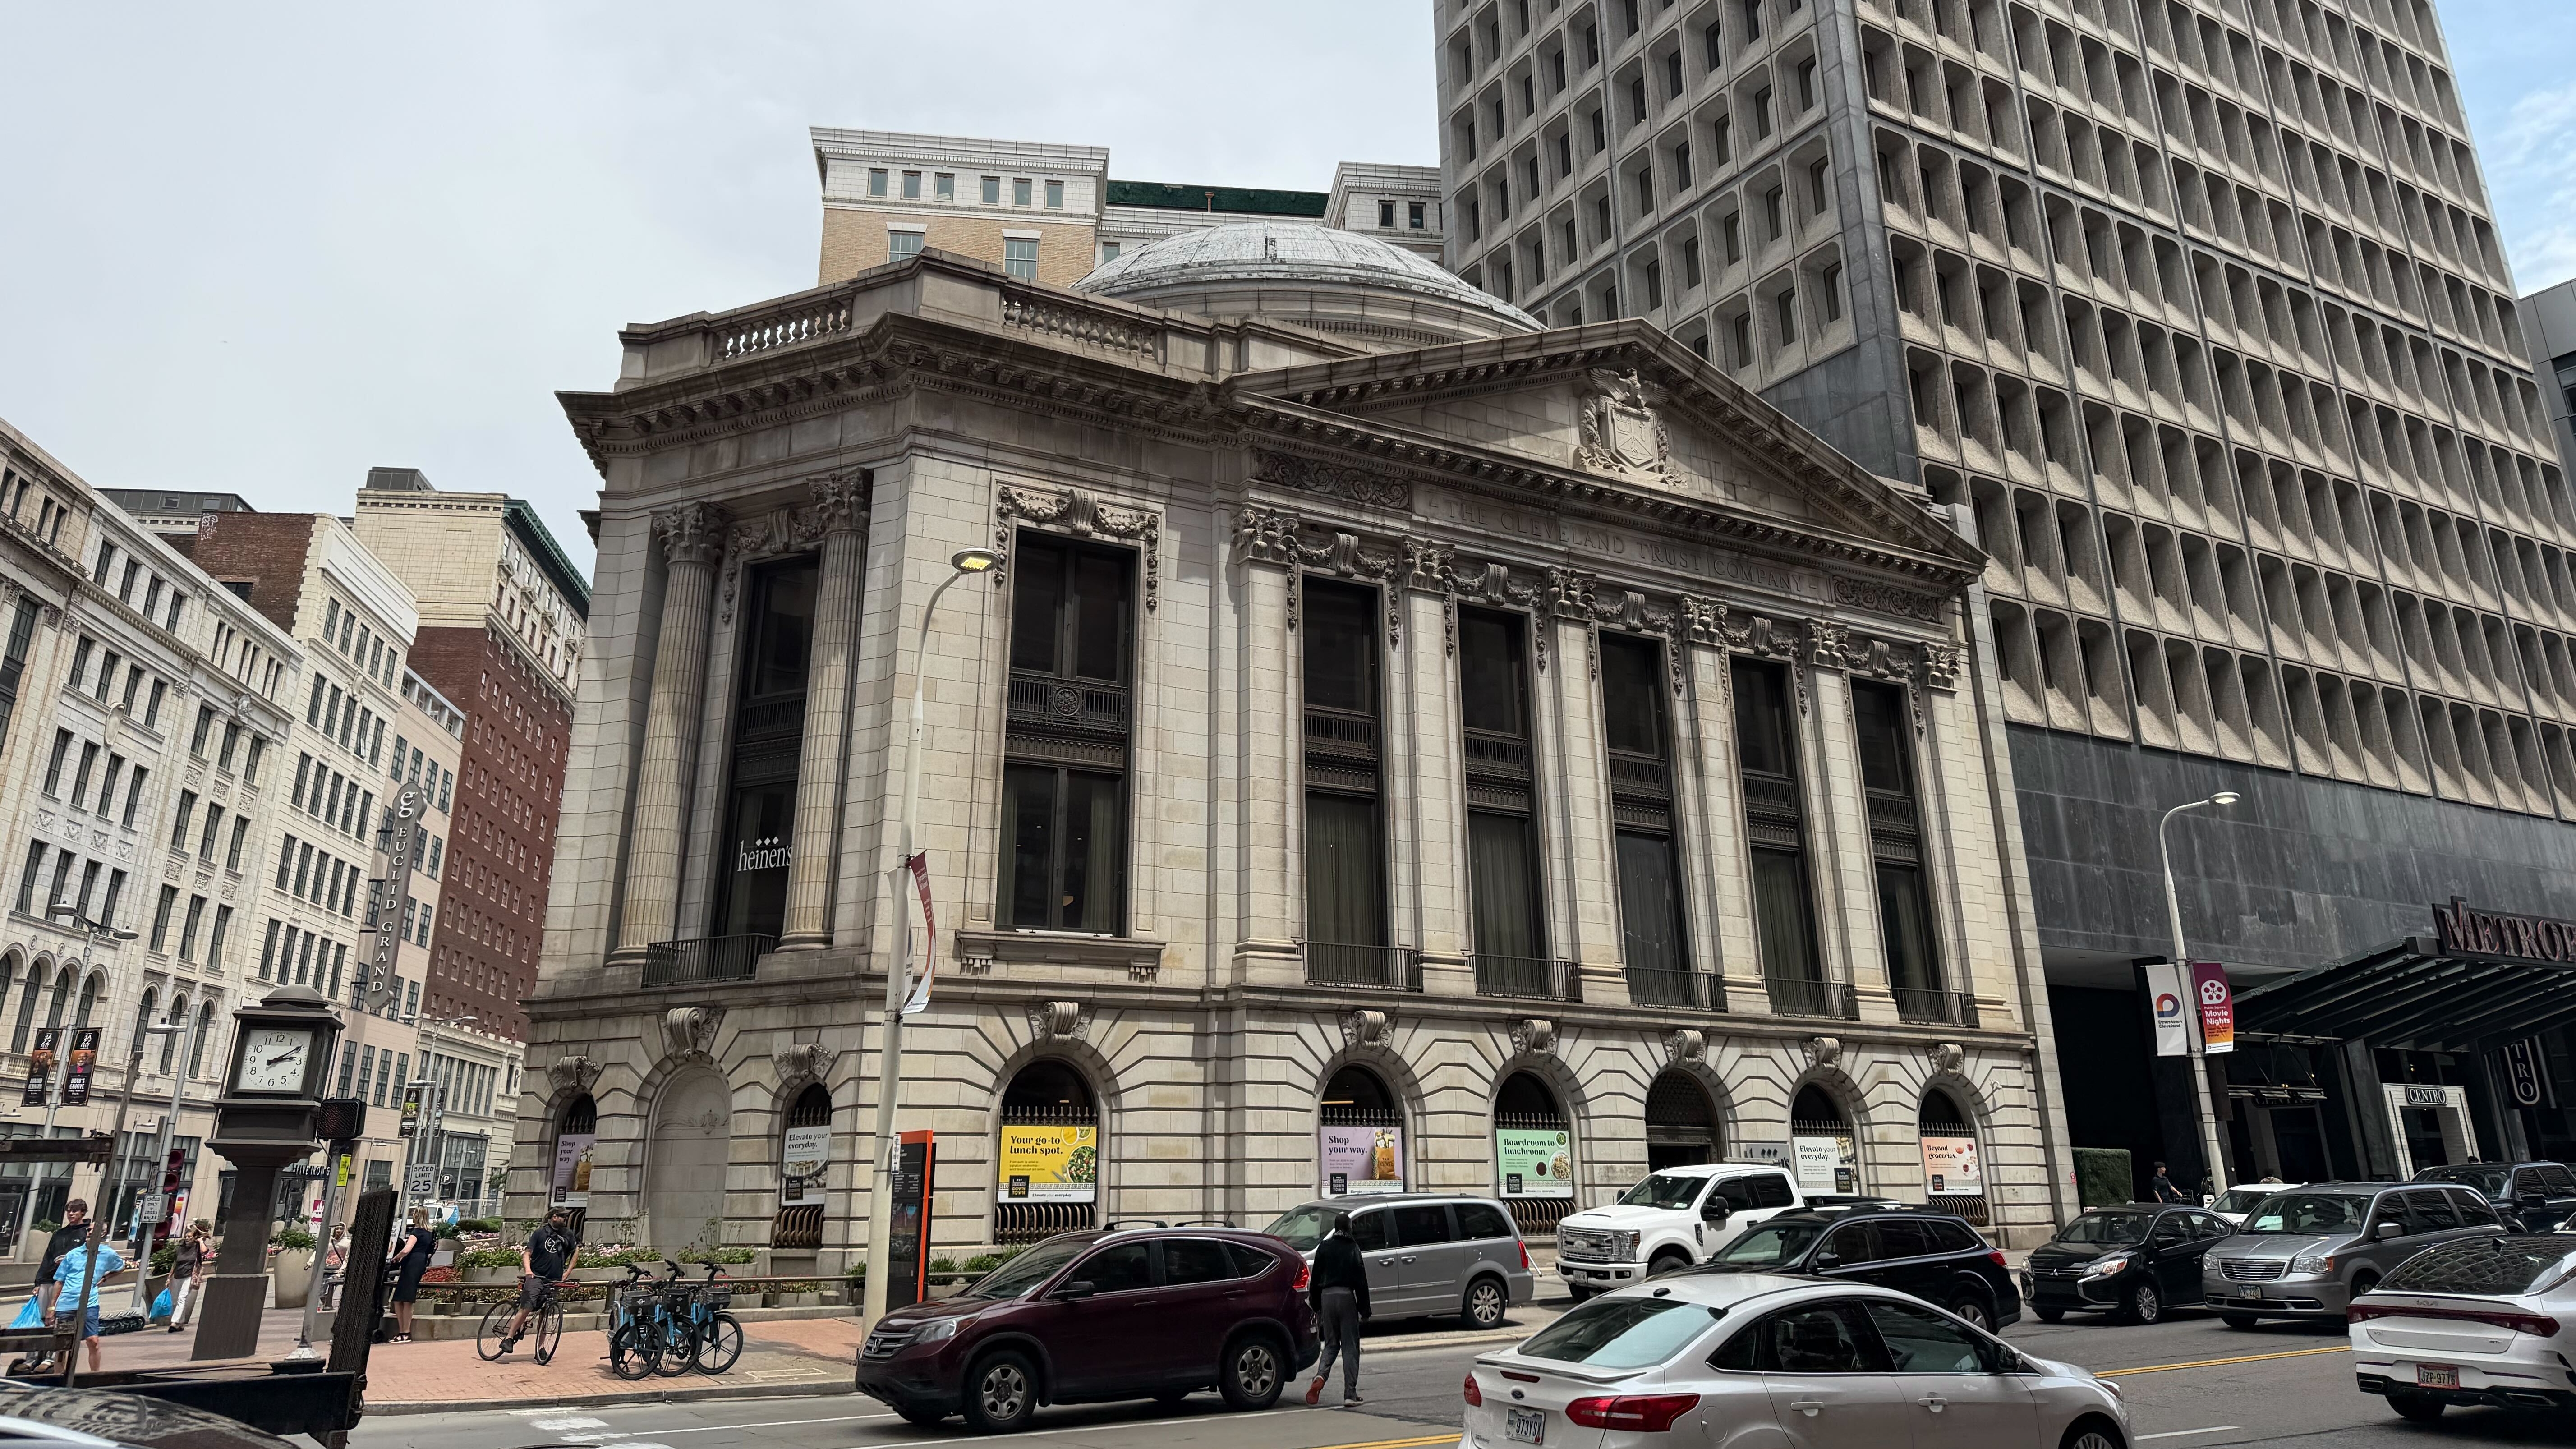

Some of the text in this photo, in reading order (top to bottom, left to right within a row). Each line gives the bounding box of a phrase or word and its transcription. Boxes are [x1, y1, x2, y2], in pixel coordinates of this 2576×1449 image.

[1447, 501, 1802, 592] THE CLEVELAND TRUST COMPANY
[737, 840, 792, 871] heinen's
[385, 827, 408, 910] EUCLID
[372, 921, 393, 992] GRAND
[2206, 1017, 2231, 1026] Nights
[276, 1034, 285, 1043] 12
[253, 1044, 263, 1053] 10
[249, 1056, 302, 1065] 9 3
[250, 1067, 257, 1075] 8
[267, 1078, 274, 1087] 6
[2410, 1089, 2445, 1103] CENTRO
[1011, 1136, 1060, 1146] Your go-to
[1329, 1136, 1349, 1145] Shop
[788, 1141, 817, 1150] everyday.
[1927, 1145, 1948, 1153] Beyond
[1010, 1145, 1063, 1156] lunch spot.
[1350, 1147, 1367, 1155] way.
[1504, 1147, 1547, 1155] lunchroom.
[1801, 1153, 1830, 1161] everyday.
[296, 1165, 309, 1175] FIVE
[310, 1166, 324, 1176] IRON
[411, 1180, 431, 1192] 25
[1516, 1418, 1541, 1437] 973YSX
